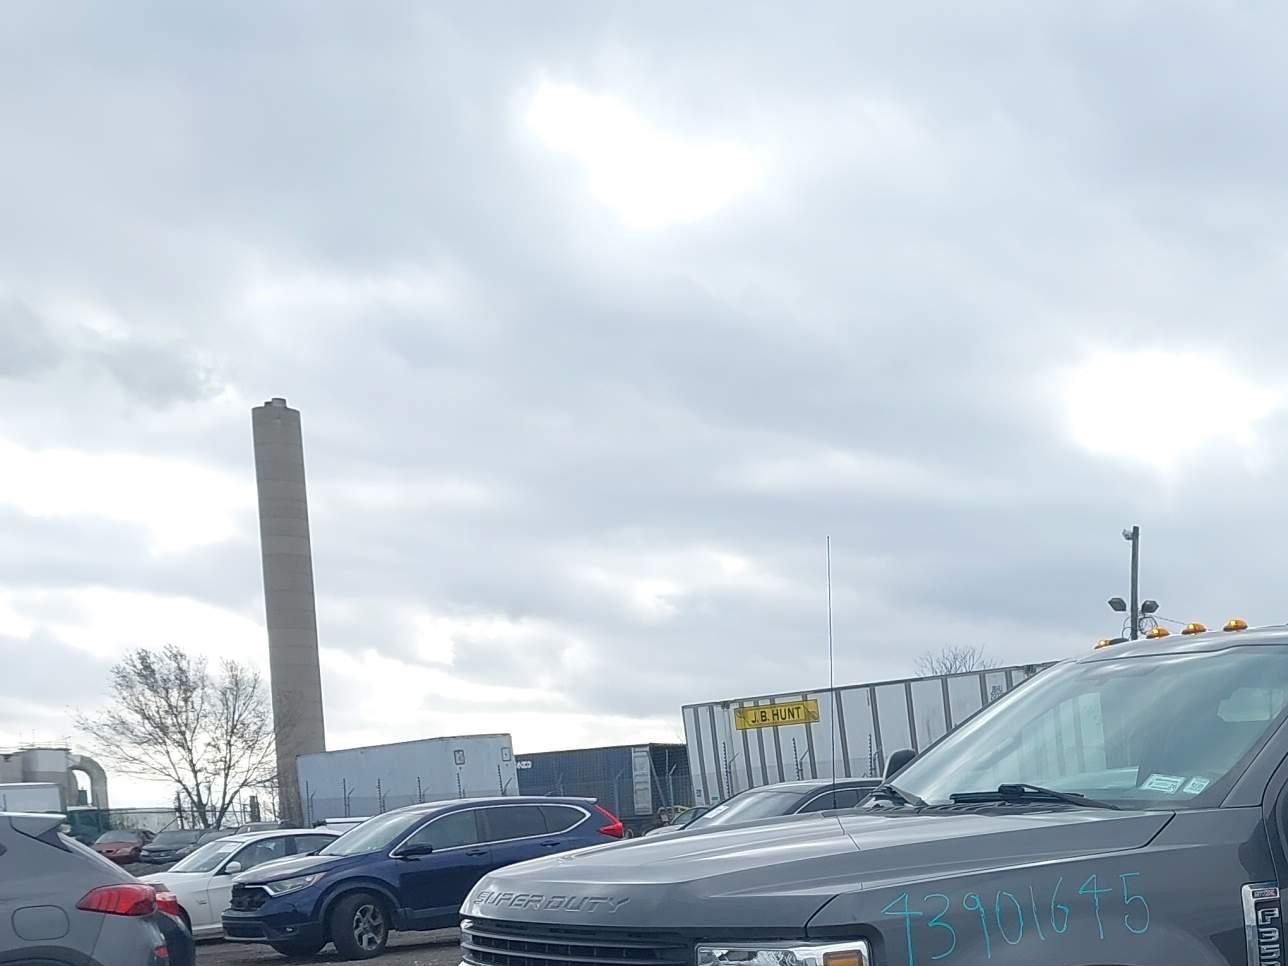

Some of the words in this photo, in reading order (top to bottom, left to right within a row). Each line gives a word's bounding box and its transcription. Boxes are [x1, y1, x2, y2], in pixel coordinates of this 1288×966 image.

[772, 706, 801, 721] HUNT
[473, 890, 545, 910] SUPER
[543, 895, 631, 913] DUTY
